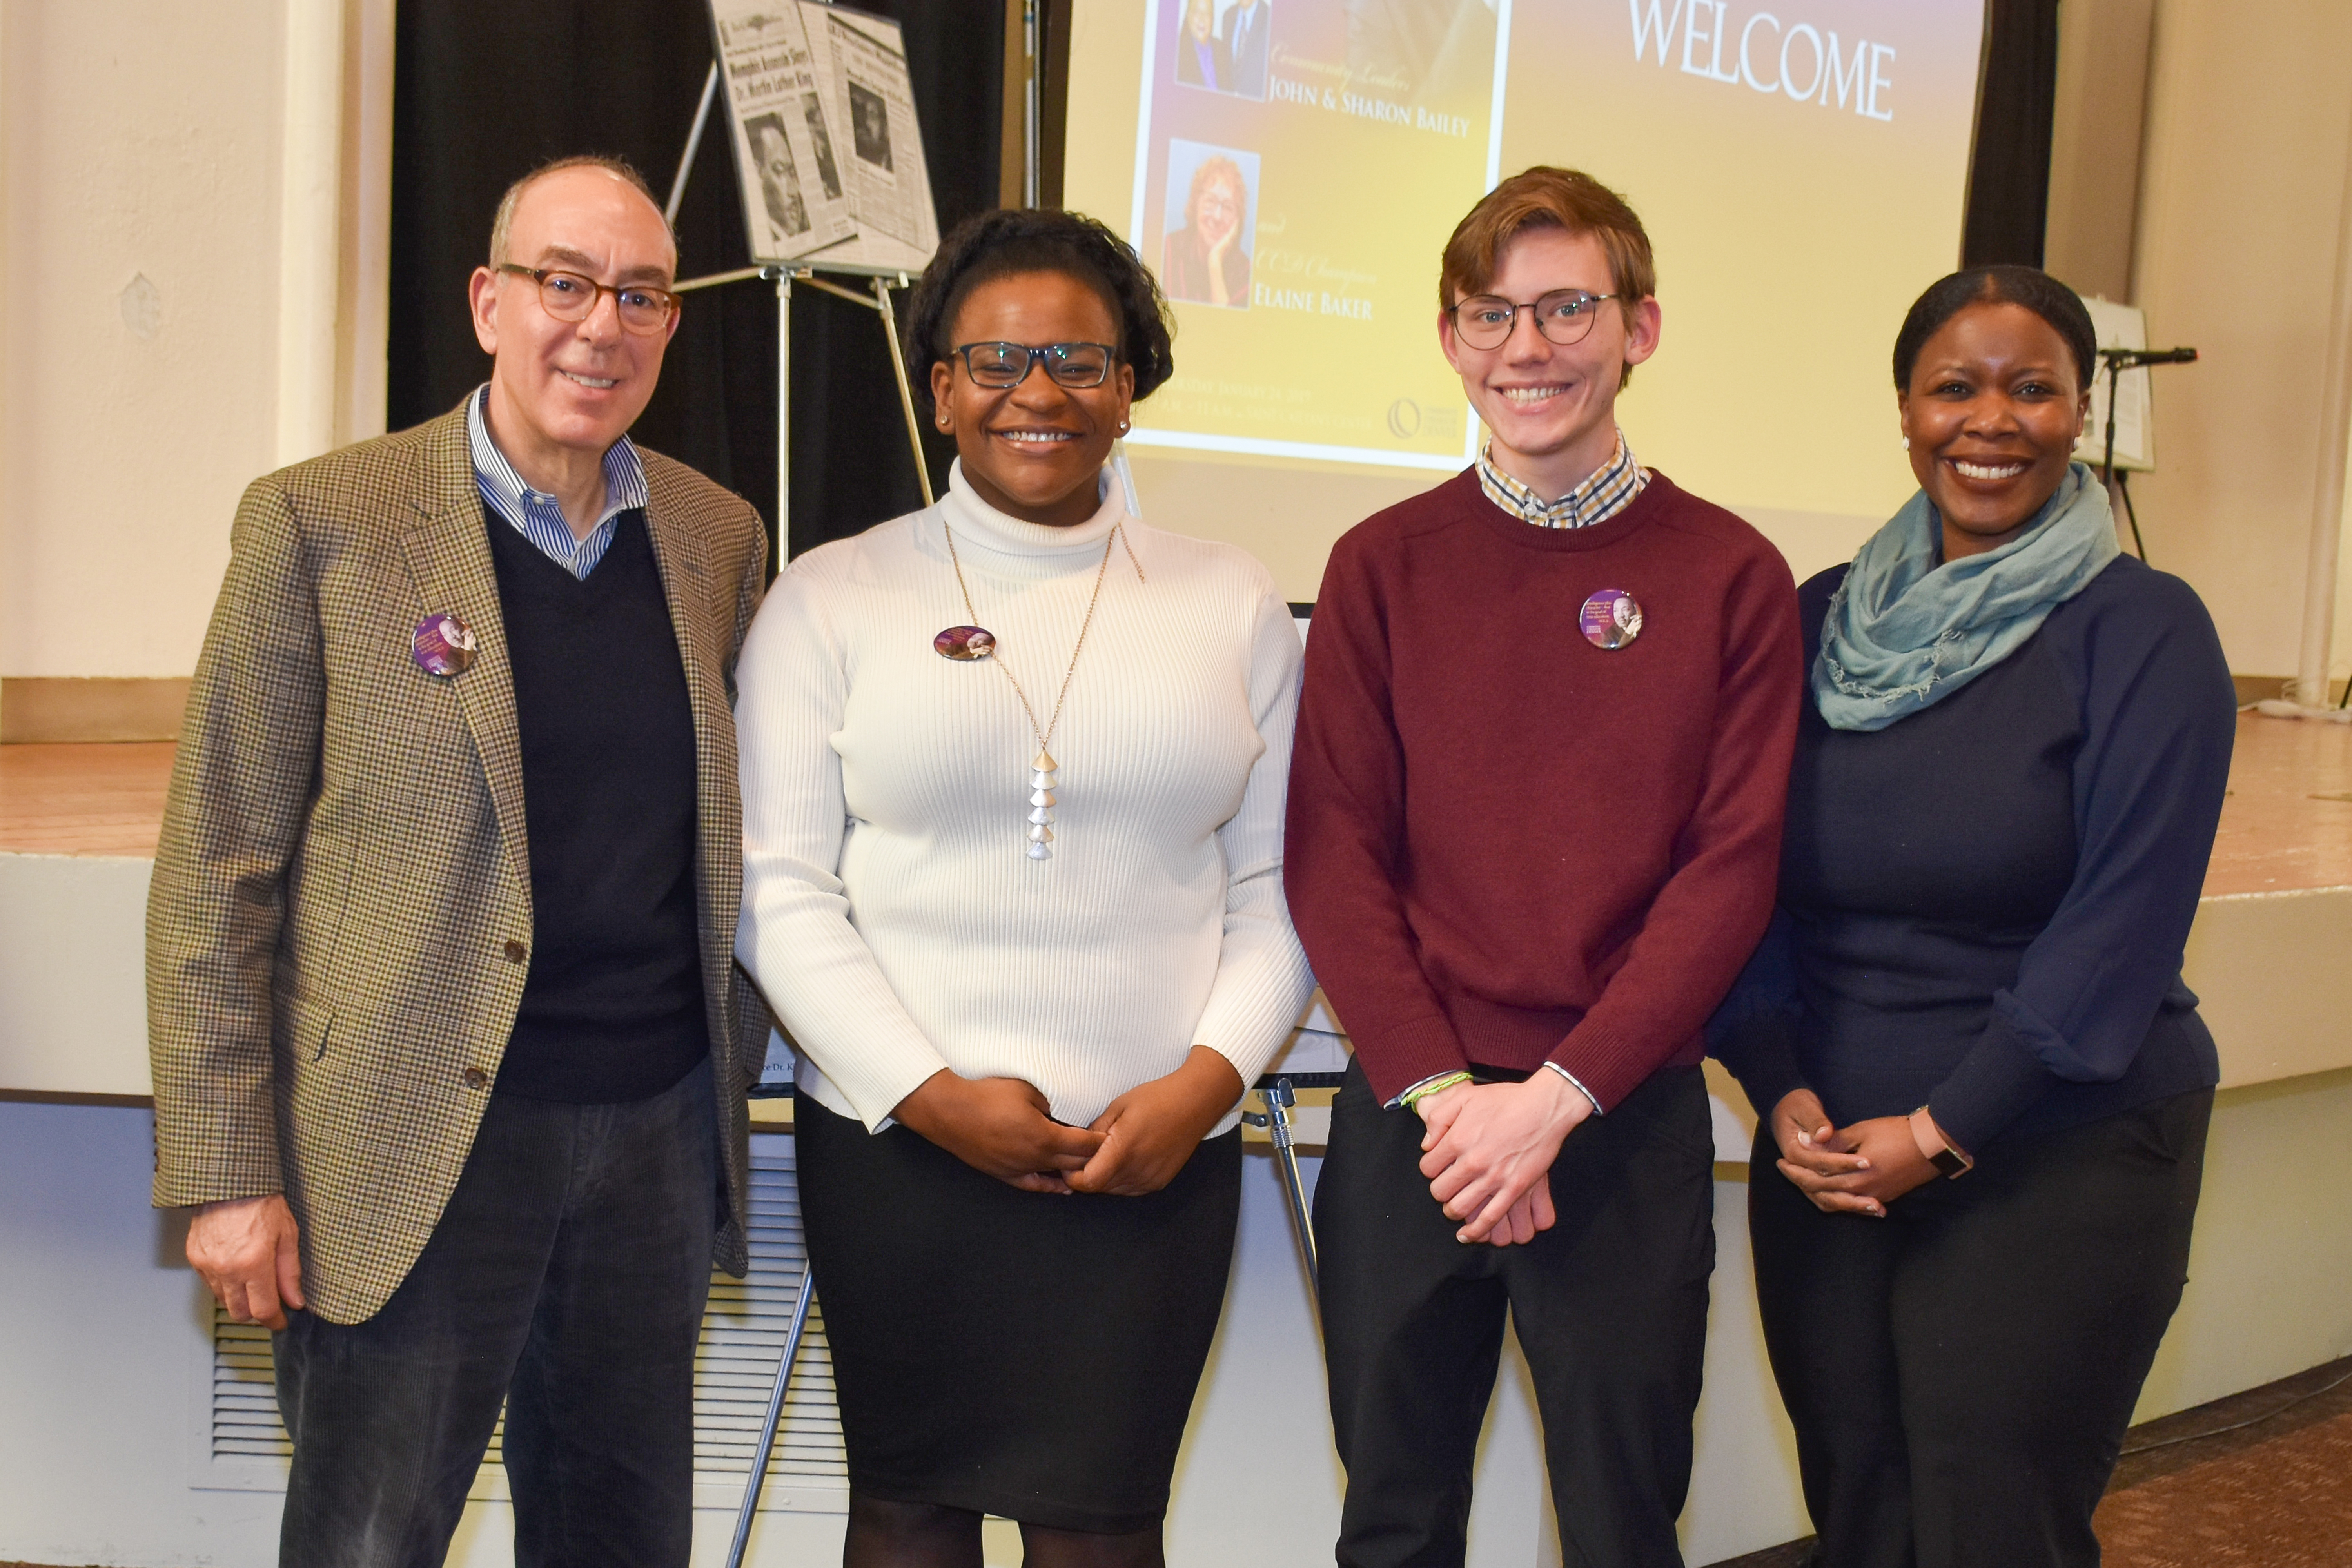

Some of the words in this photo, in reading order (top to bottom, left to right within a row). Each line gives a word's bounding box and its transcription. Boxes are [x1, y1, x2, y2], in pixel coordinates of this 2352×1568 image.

[735, 86, 750, 102] Dr.
[748, 79, 773, 98] Martin
[772, 74, 795, 93] Luther
[795, 70, 814, 89] King
[1270, 42, 1353, 92] Community
[1628, 0, 1896, 122] WELCOME
[1269, 75, 1319, 107] JOHN
[1322, 86, 1338, 112] &
[1342, 92, 1412, 125] SHARON
[1418, 107, 1470, 137] BAILEY
[1256, 282, 1315, 313] ELAINE
[1321, 292, 1373, 320] BAKER
